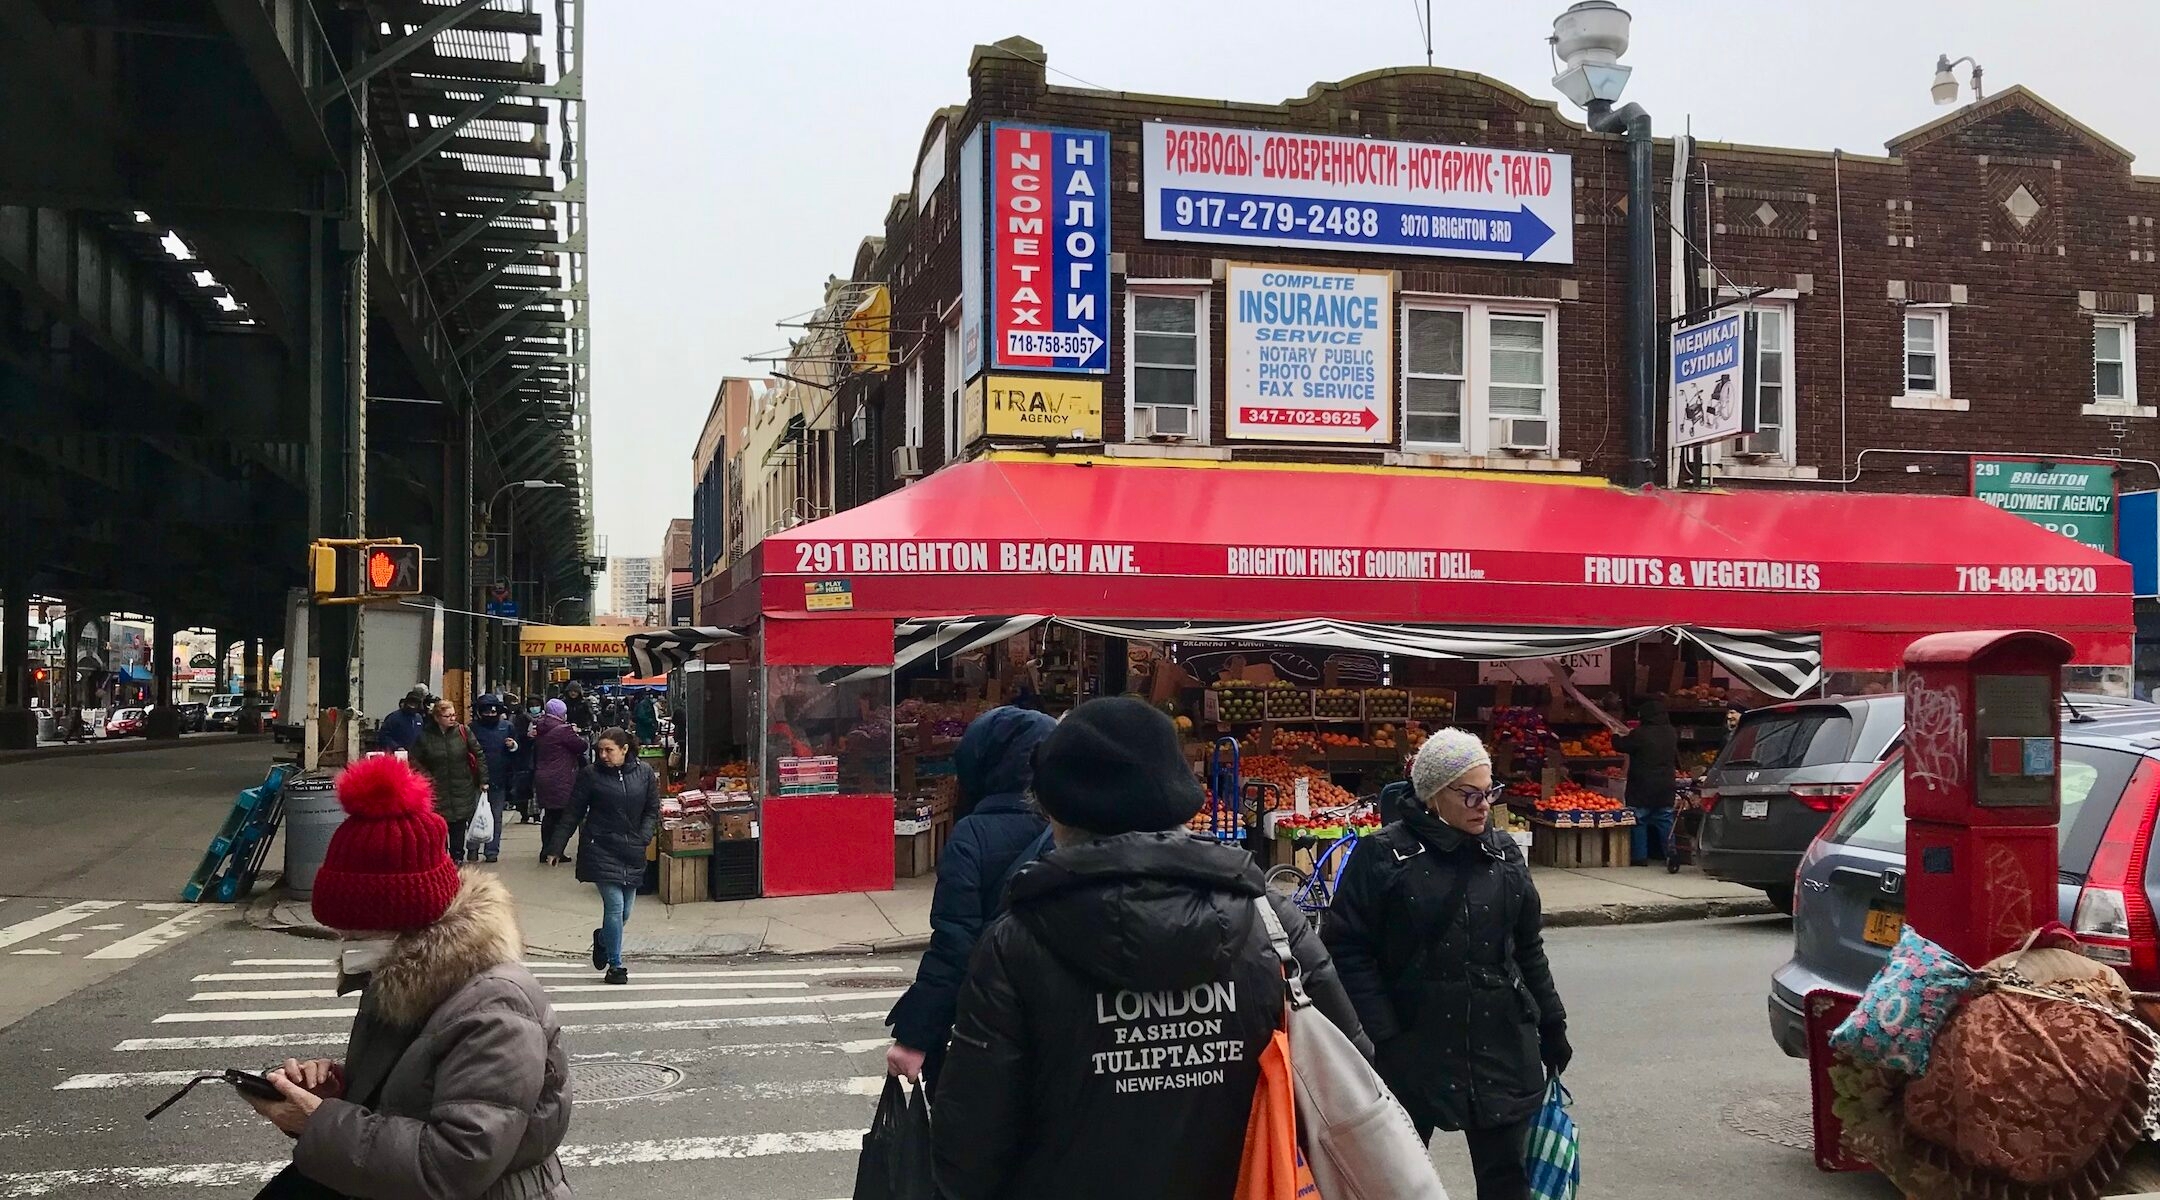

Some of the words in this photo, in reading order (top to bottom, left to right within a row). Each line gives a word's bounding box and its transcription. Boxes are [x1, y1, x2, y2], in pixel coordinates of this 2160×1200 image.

[1166, 129, 1252, 177] РАЗВОДЫ
[1263, 136, 1398, 187] ДОВЕРЕННОСТИ
[1408, 147, 1493, 195] НОТАРИУС
[1502, 155, 1533, 198] TAX
[1536, 157, 1552, 196] ID
[1009, 132, 1043, 256] INCOME
[1065, 138, 1096, 321] НАЛОГИ
[1175, 196, 1379, 238] 917-279-2488
[1401, 213, 1429, 237] 3070
[1431, 216, 1487, 241] BRIGHTON
[1490, 219, 1512, 243] 3RD
[1262, 273, 1355, 291] COMPLETE
[1010, 264, 1042, 326] TAX
[1239, 290, 1378, 329] INSURANCE
[1010, 333, 1095, 355] 718-758-5057
[1255, 328, 1363, 345] SERVICE
[1676, 320, 1738, 355] МЕДИКАЛ
[1260, 346, 1317, 363] NOTARY
[1325, 349, 1374, 366] PUBLIC
[1681, 343, 1733, 377] СУПЛАЙ
[1260, 363, 1312, 380] PHOTO
[1319, 365, 1375, 383] COPIES
[1259, 381, 1294, 397] FAX
[1303, 382, 1375, 400] SERVICE
[1020, 414, 1069, 424] AGENCY
[1248, 409, 1362, 425] 347-702-9625
[1976, 463, 2000, 476] 291
[2010, 471, 2089, 486] BRIGHTON
[1978, 492, 2059, 511] EMPLOYMENT
[2062, 495, 2111, 512] AGENCY
[795, 542, 845, 572] 291
[852, 542, 988, 572] BRIGHTON
[1000, 543, 1085, 572] BEACH
[1088, 545, 1140, 573] AVE.
[1227, 547, 1307, 576] BRIGHTON
[1310, 549, 1361, 577] FINEST
[1364, 550, 1437, 578] GOURMET
[1584, 556, 1663, 586] FRUITS
[1668, 562, 1685, 586] &
[1690, 560, 1820, 590] VEGETABLES
[1955, 566, 2097, 592] 718-484-8320
[525, 642, 546, 653] 277
[555, 643, 627, 653] PHARMACY
[1096, 981, 1237, 1024] LONDON
[1114, 1019, 1222, 1044] FASHION
[1091, 1040, 1244, 1074] TULIPTASTE
[1115, 1069, 1224, 1094] NEWFASHION
